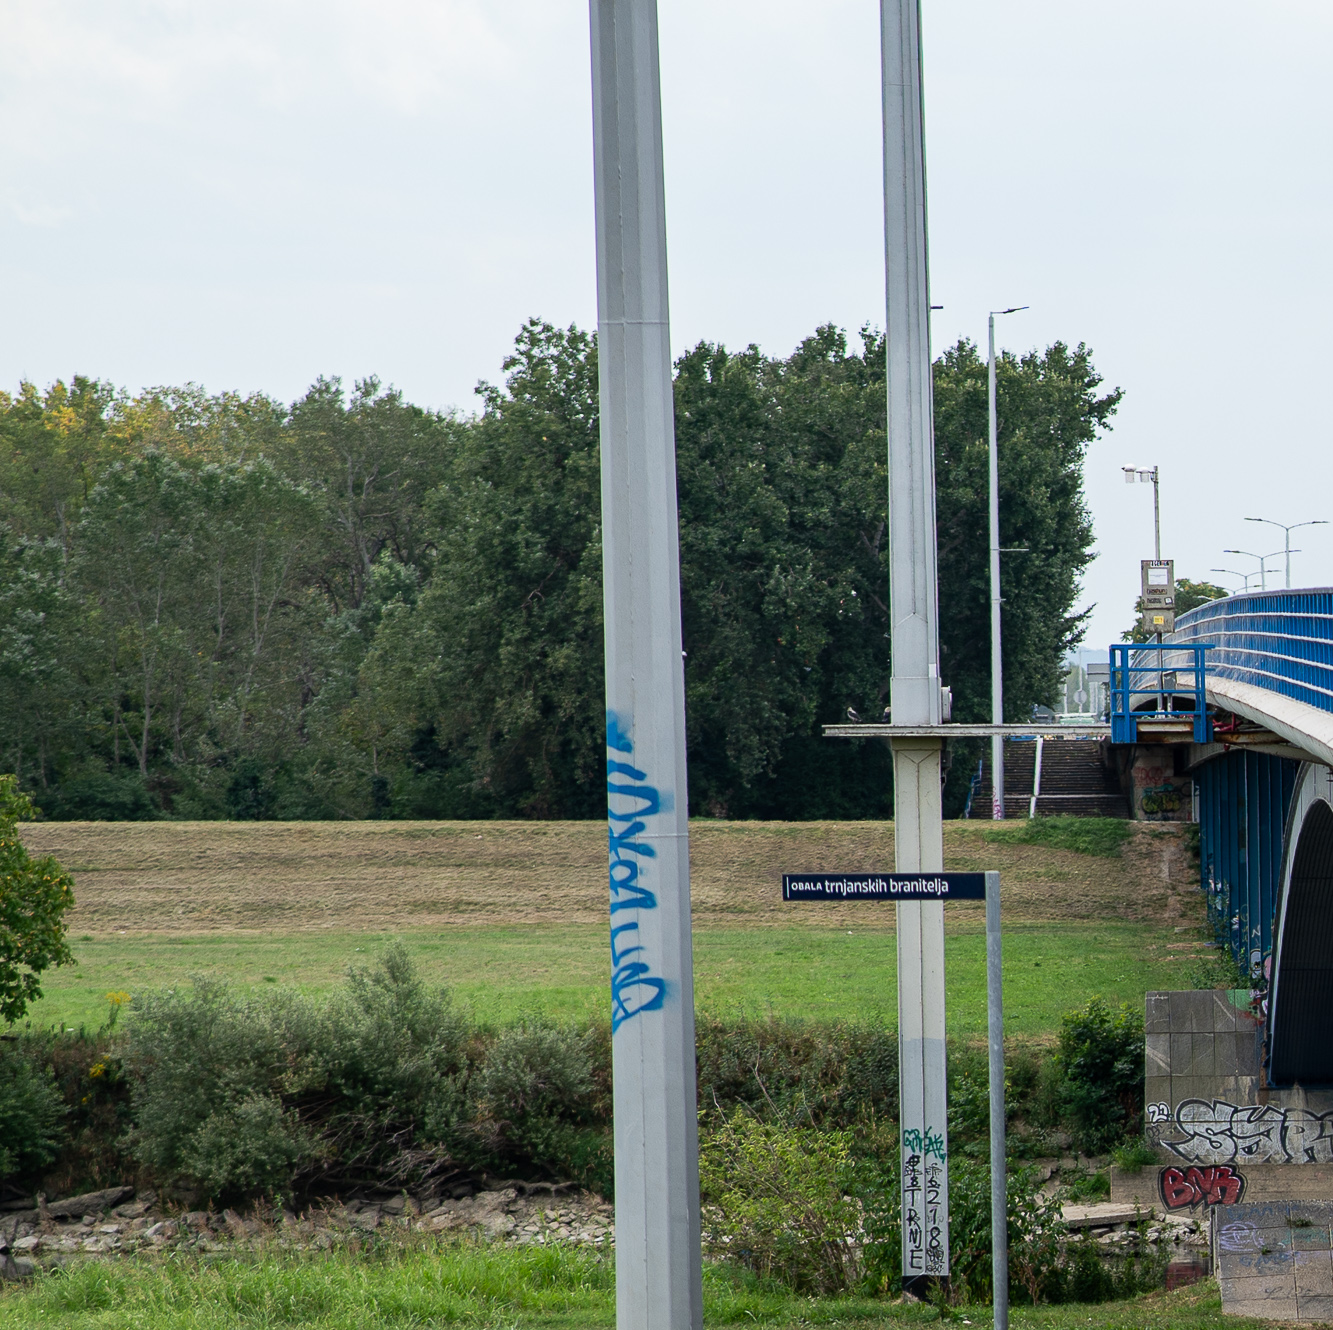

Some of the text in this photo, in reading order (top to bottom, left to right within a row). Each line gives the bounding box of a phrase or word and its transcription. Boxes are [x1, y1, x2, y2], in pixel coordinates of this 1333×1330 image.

[791, 878, 949, 896] OBALA trnjanskih branitelja
